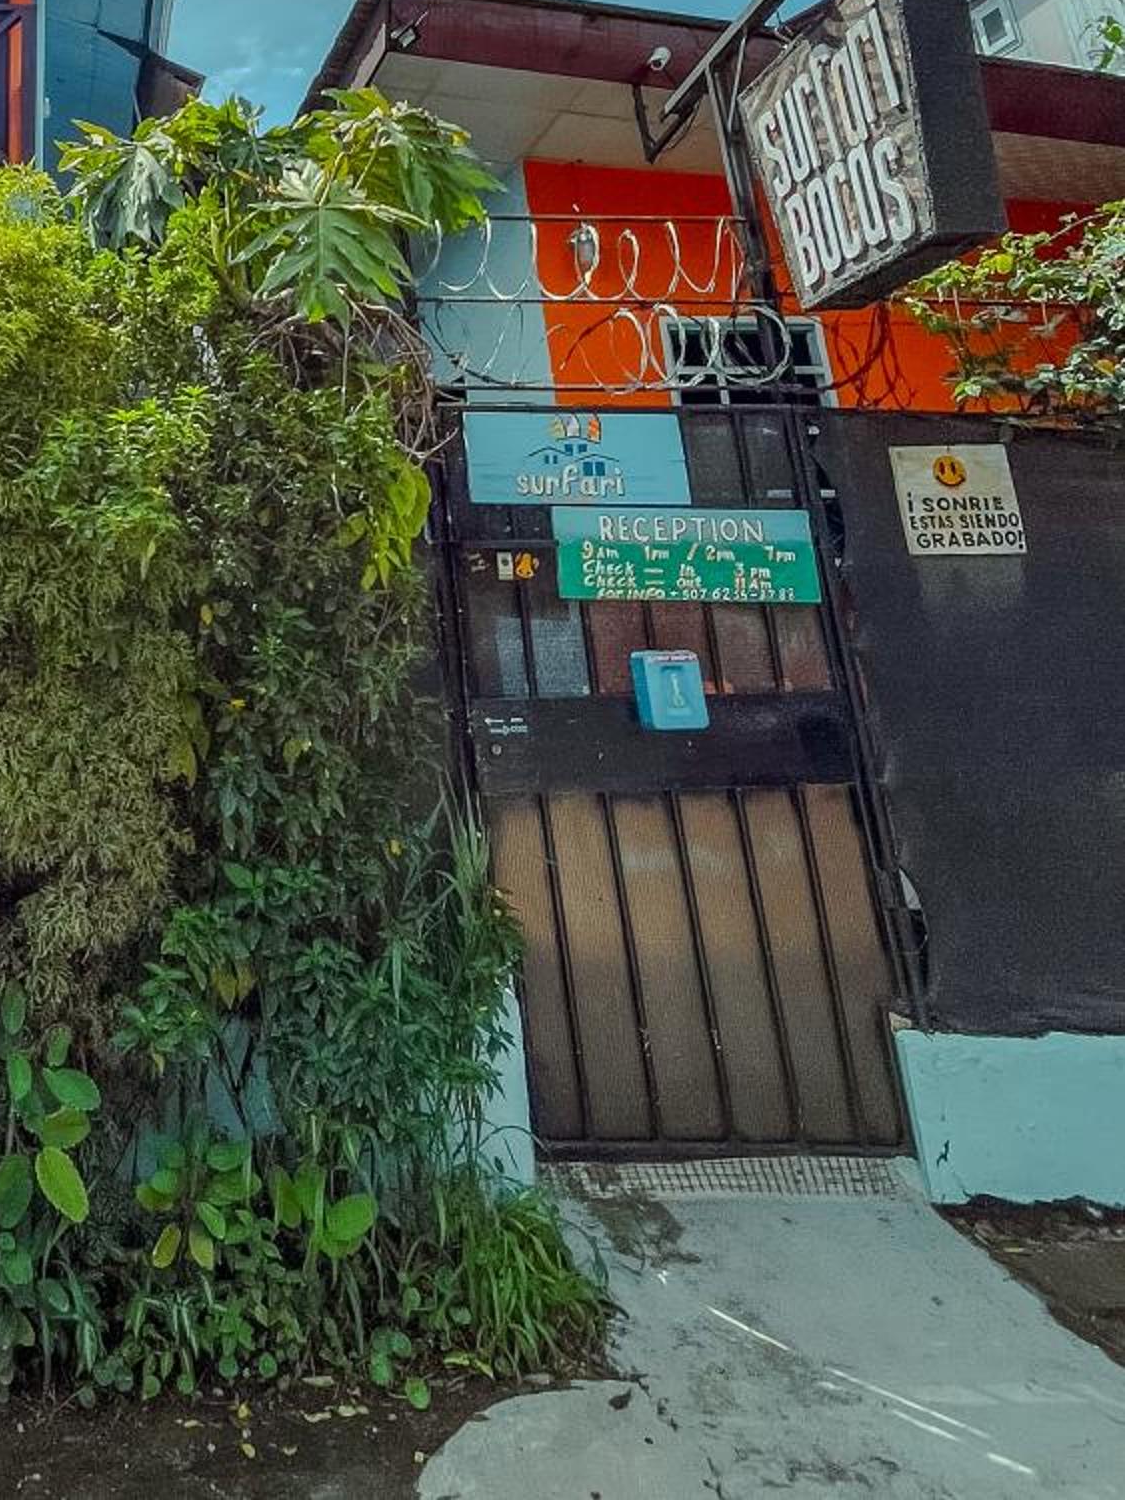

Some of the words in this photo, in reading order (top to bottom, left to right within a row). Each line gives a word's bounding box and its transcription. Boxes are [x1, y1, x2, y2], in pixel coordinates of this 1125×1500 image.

[516, 465, 625, 497] surfari
[922, 496, 1004, 513] SONRIE
[598, 515, 765, 542] RECEPTION
[909, 515, 954, 530] ESTAS
[959, 512, 1020, 529] SIENDO
[916, 530, 1024, 550] GRABADO!
